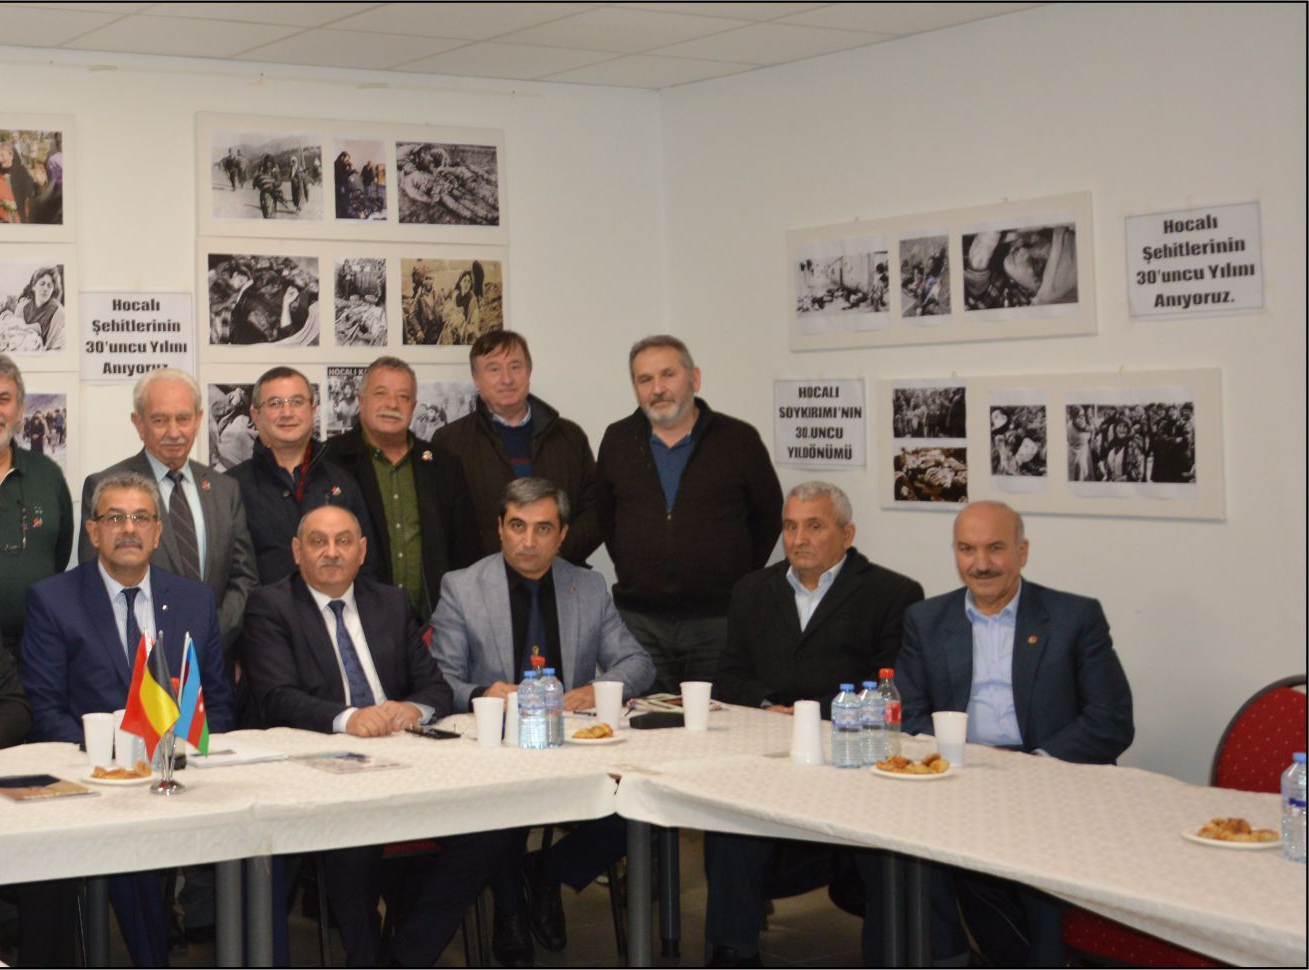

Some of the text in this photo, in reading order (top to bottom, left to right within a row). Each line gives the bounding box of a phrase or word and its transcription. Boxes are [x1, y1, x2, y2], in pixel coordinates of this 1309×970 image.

[1163, 214, 1219, 234] Hocalı
[1142, 237, 1246, 264] Şehitlerinin
[1136, 262, 1255, 285] 30'uncu Yılını
[112, 298, 161, 312] Hocalı
[1154, 291, 1235, 309] Anıyoruz.
[92, 319, 181, 336] Şehitlerinin
[85, 340, 188, 354] 30'uncu Yılını
[798, 386, 840, 399] HOCALI
[779, 406, 862, 419] SOYKIRIMI'NIN
[795, 426, 844, 439] 30.UNCU
[788, 443, 853, 460] YILDÖNÜMÜ
